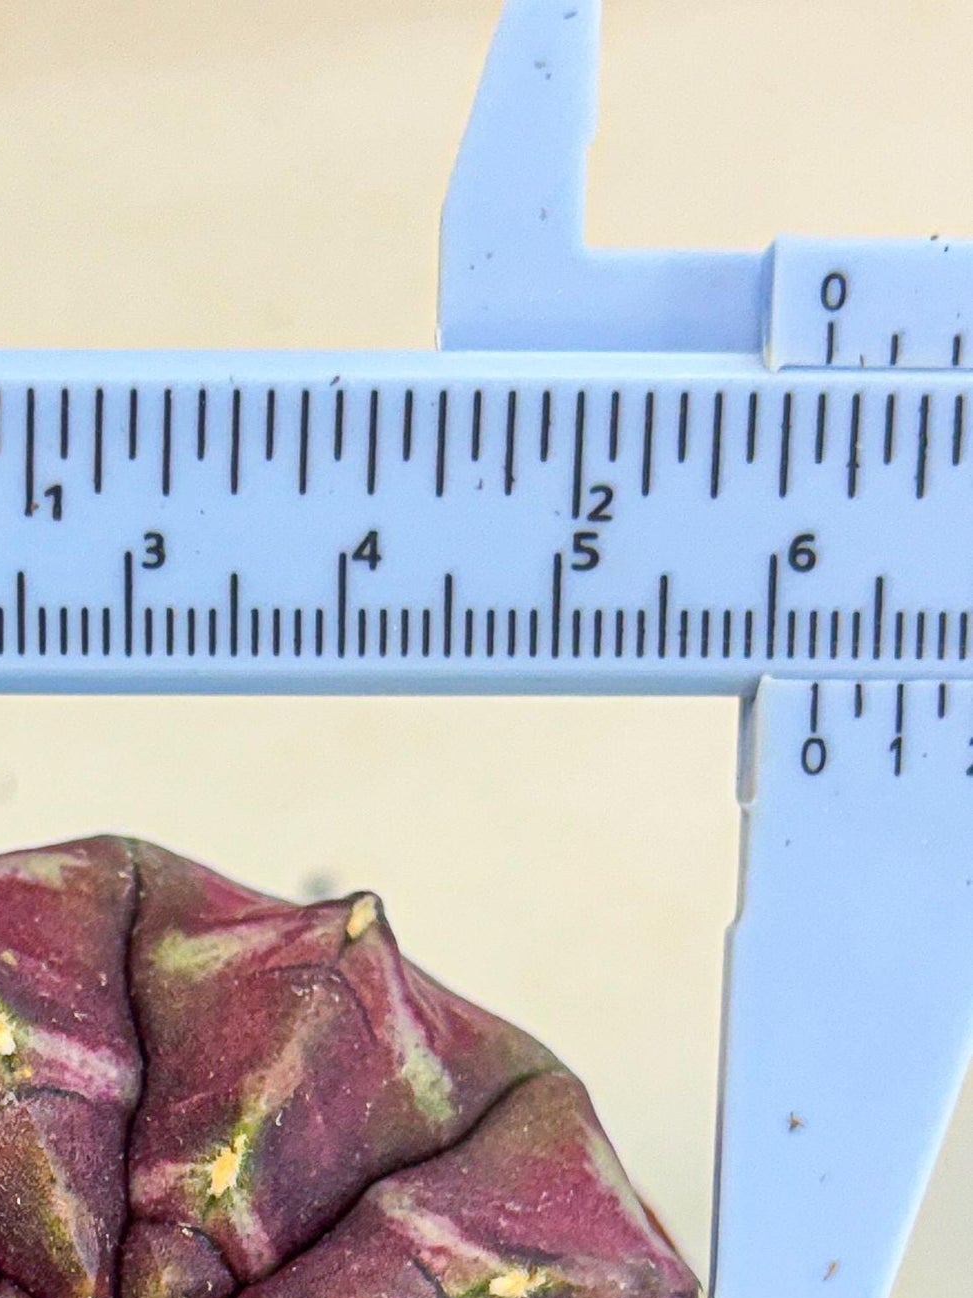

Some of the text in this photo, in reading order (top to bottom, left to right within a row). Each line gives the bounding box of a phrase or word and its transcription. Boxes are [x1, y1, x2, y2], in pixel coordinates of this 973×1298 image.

[820, 271, 848, 312] 0
[43, 484, 64, 522] 1
[587, 484, 615, 522] 2
[141, 531, 167, 570] 3
[350, 529, 382, 571] 4
[570, 531, 601, 572] 5
[787, 533, 818, 573] 6
[800, 736, 903, 777] 0 1
